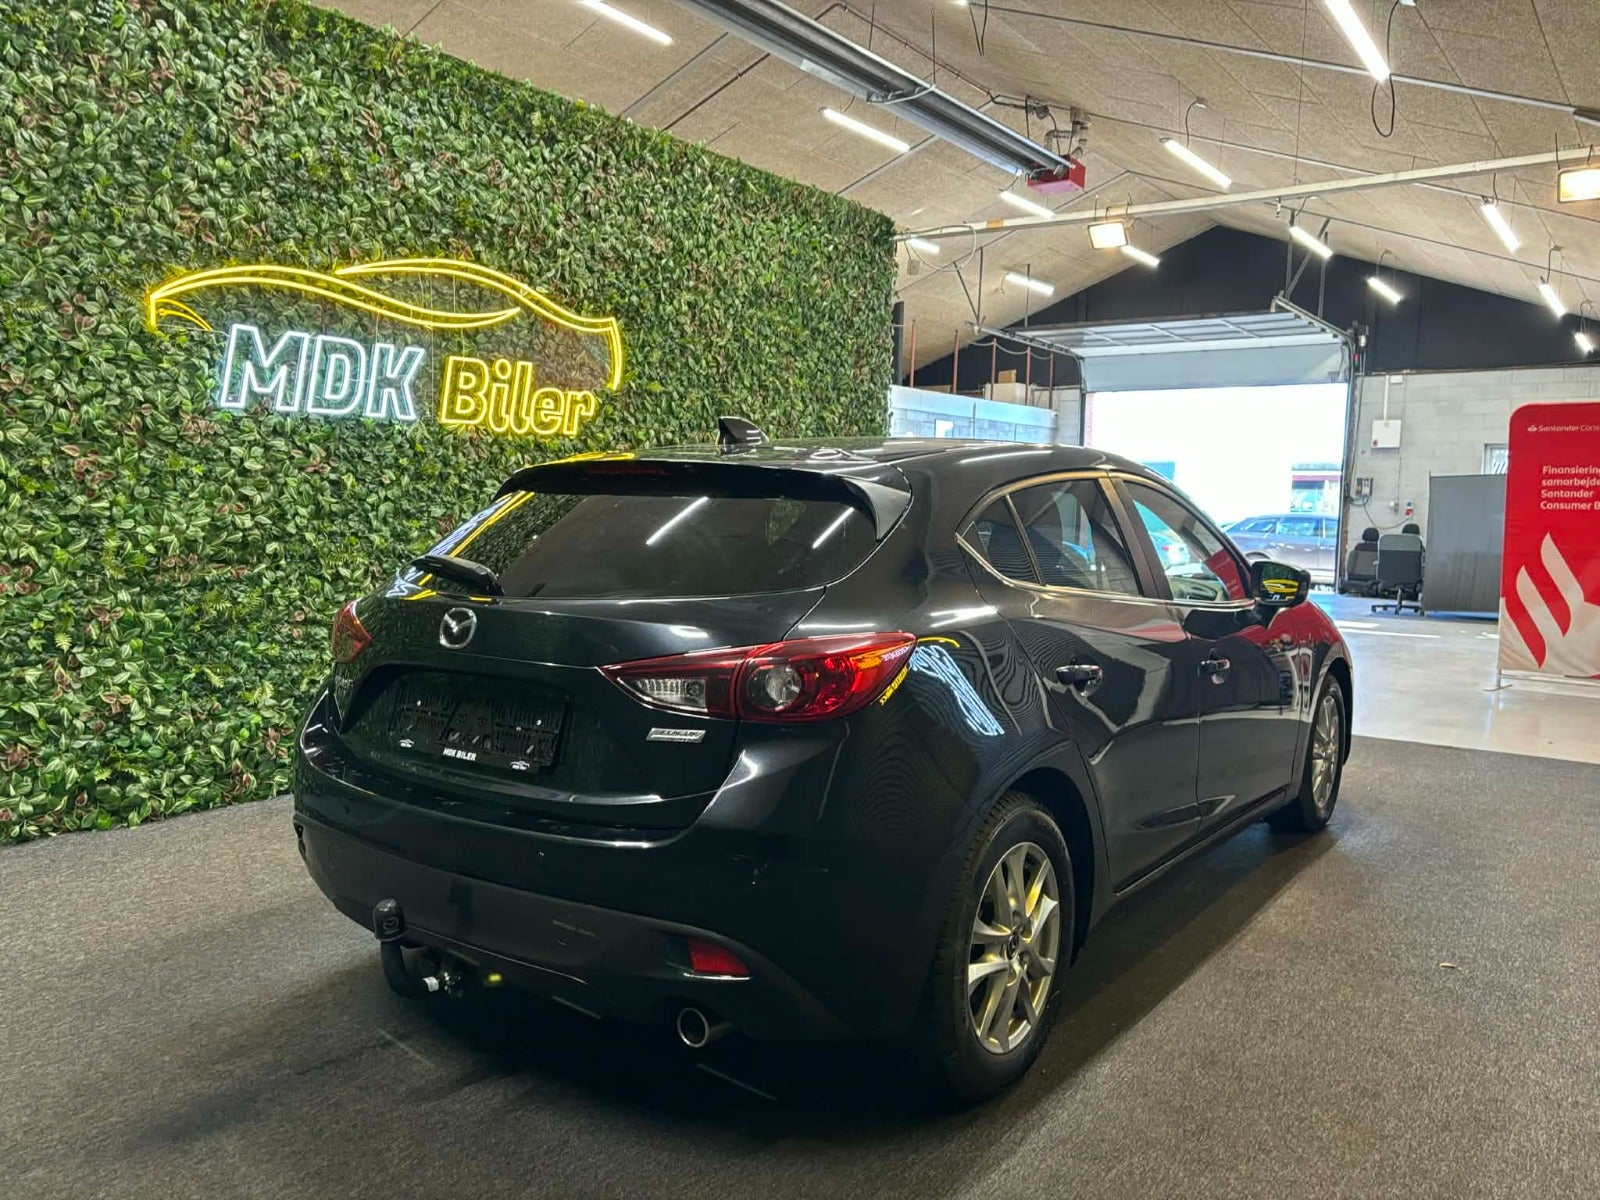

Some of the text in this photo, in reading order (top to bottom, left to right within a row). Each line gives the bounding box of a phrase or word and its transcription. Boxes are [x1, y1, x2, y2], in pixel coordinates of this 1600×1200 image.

[219, 323, 596, 436] MDK Biler
[1541, 489, 1594, 498] Santander
[1540, 501, 1592, 510] Consumer
